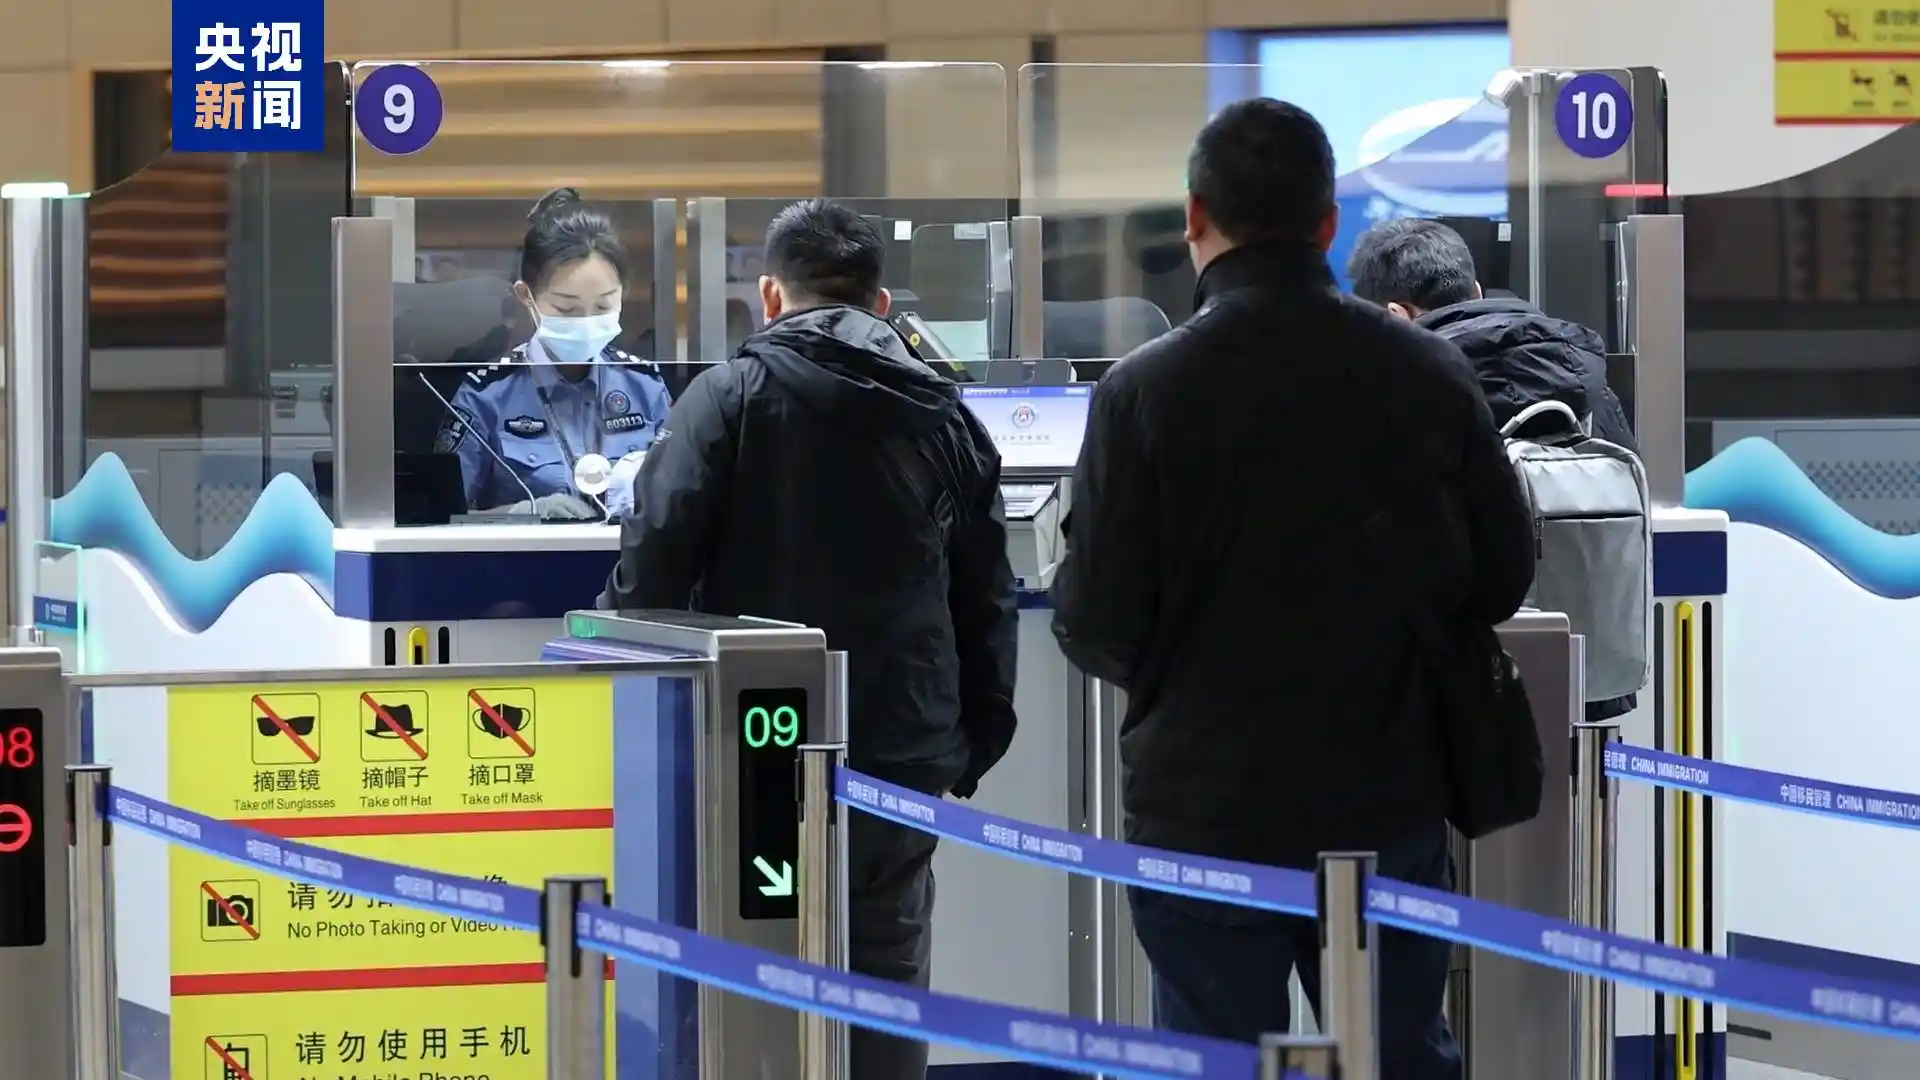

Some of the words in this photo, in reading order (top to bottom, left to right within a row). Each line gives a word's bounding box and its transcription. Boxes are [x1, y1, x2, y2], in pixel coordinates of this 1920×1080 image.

[383, 84, 415, 134] 9
[1572, 91, 1617, 140] 10
[745, 706, 799, 748] 09
[0, 727, 34, 768] 8
[254, 769, 320, 792] 摘墨镜
[362, 766, 428, 789] 摘帽子
[469, 763, 535, 786] 摘口罩
[1631, 756, 1655, 775] CHINA
[1657, 761, 1709, 785] IMMIGRATION
[233, 799, 259, 811] Take
[261, 799, 274, 810] off
[277, 798, 335, 812] Sunglasses
[360, 796, 389, 808] Take
[392, 795, 407, 807] off
[411, 795, 431, 807] Hat
[461, 793, 490, 805] Take
[493, 793, 508, 805] off
[511, 792, 543, 804] Mask
[1780, 783, 1832, 809] 中国移民管理
[1837, 794, 1863, 812] CHINA
[288, 922, 312, 938] No
[317, 921, 365, 937] Photo
[369, 919, 425, 939] Taking
[430, 921, 447, 934] or
[296, 1024, 531, 1065] 请勿使用手机
